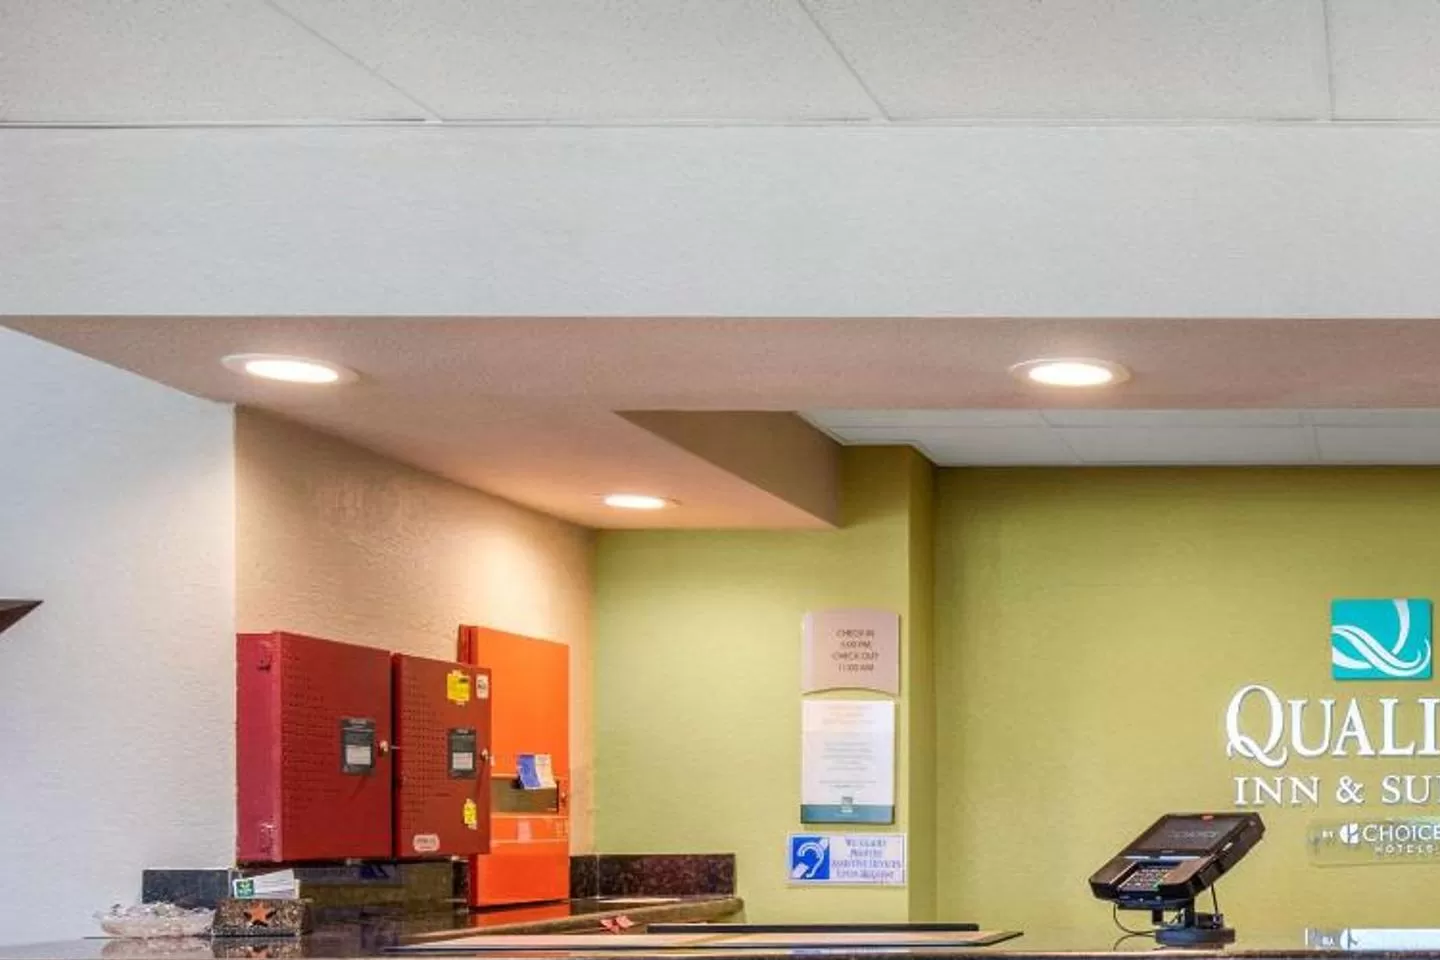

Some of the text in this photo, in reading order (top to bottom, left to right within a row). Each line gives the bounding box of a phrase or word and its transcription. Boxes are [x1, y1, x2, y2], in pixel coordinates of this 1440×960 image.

[1234, 776, 1320, 805] INN
[1336, 776, 1365, 804] &
[1375, 844, 1433, 854] HOTELS
